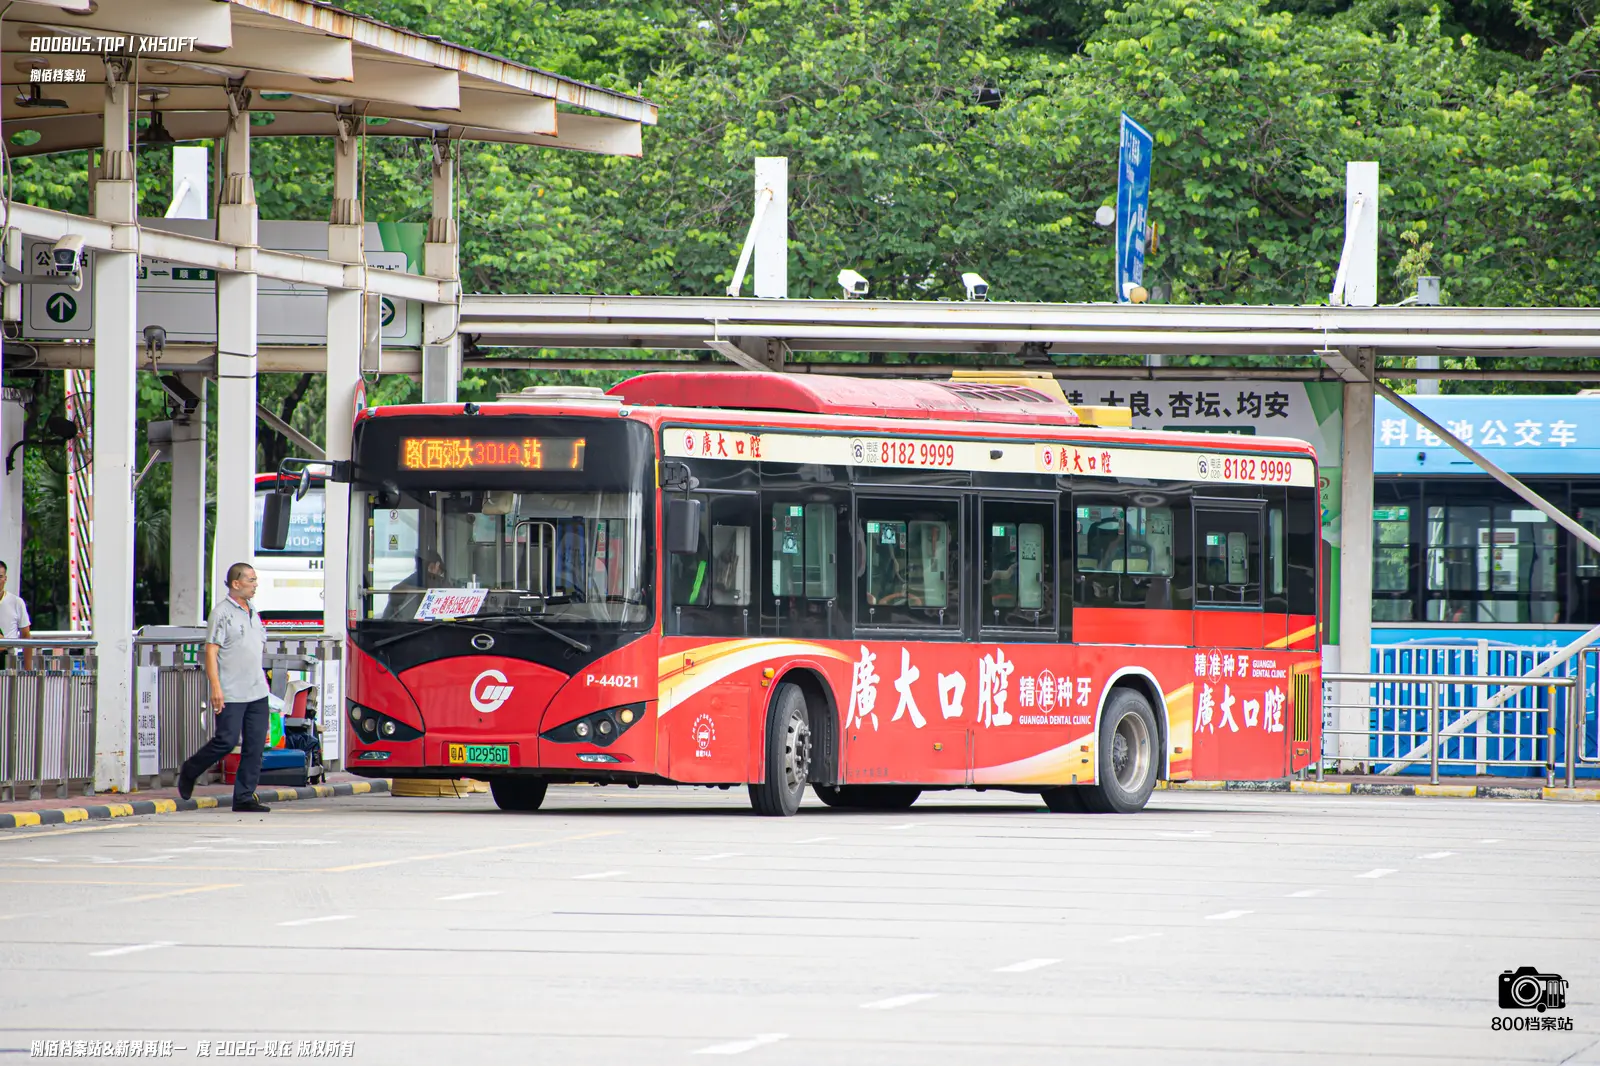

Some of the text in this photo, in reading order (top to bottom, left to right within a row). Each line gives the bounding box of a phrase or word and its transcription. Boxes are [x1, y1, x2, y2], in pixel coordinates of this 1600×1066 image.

[881, 442, 954, 466] 8182 9999
[1224, 458, 1292, 482] 8182 9999
[1194, 652, 1249, 678] 精准种牙
[1252, 660, 1276, 669] GUANGDA
[1252, 669, 1286, 678] DENTAL CLINIC
[586, 674, 638, 688] P-44021
[1019, 675, 1092, 708] 精准种牙
[1019, 715, 1091, 725] GUANGDA DENTAL CLINIC
